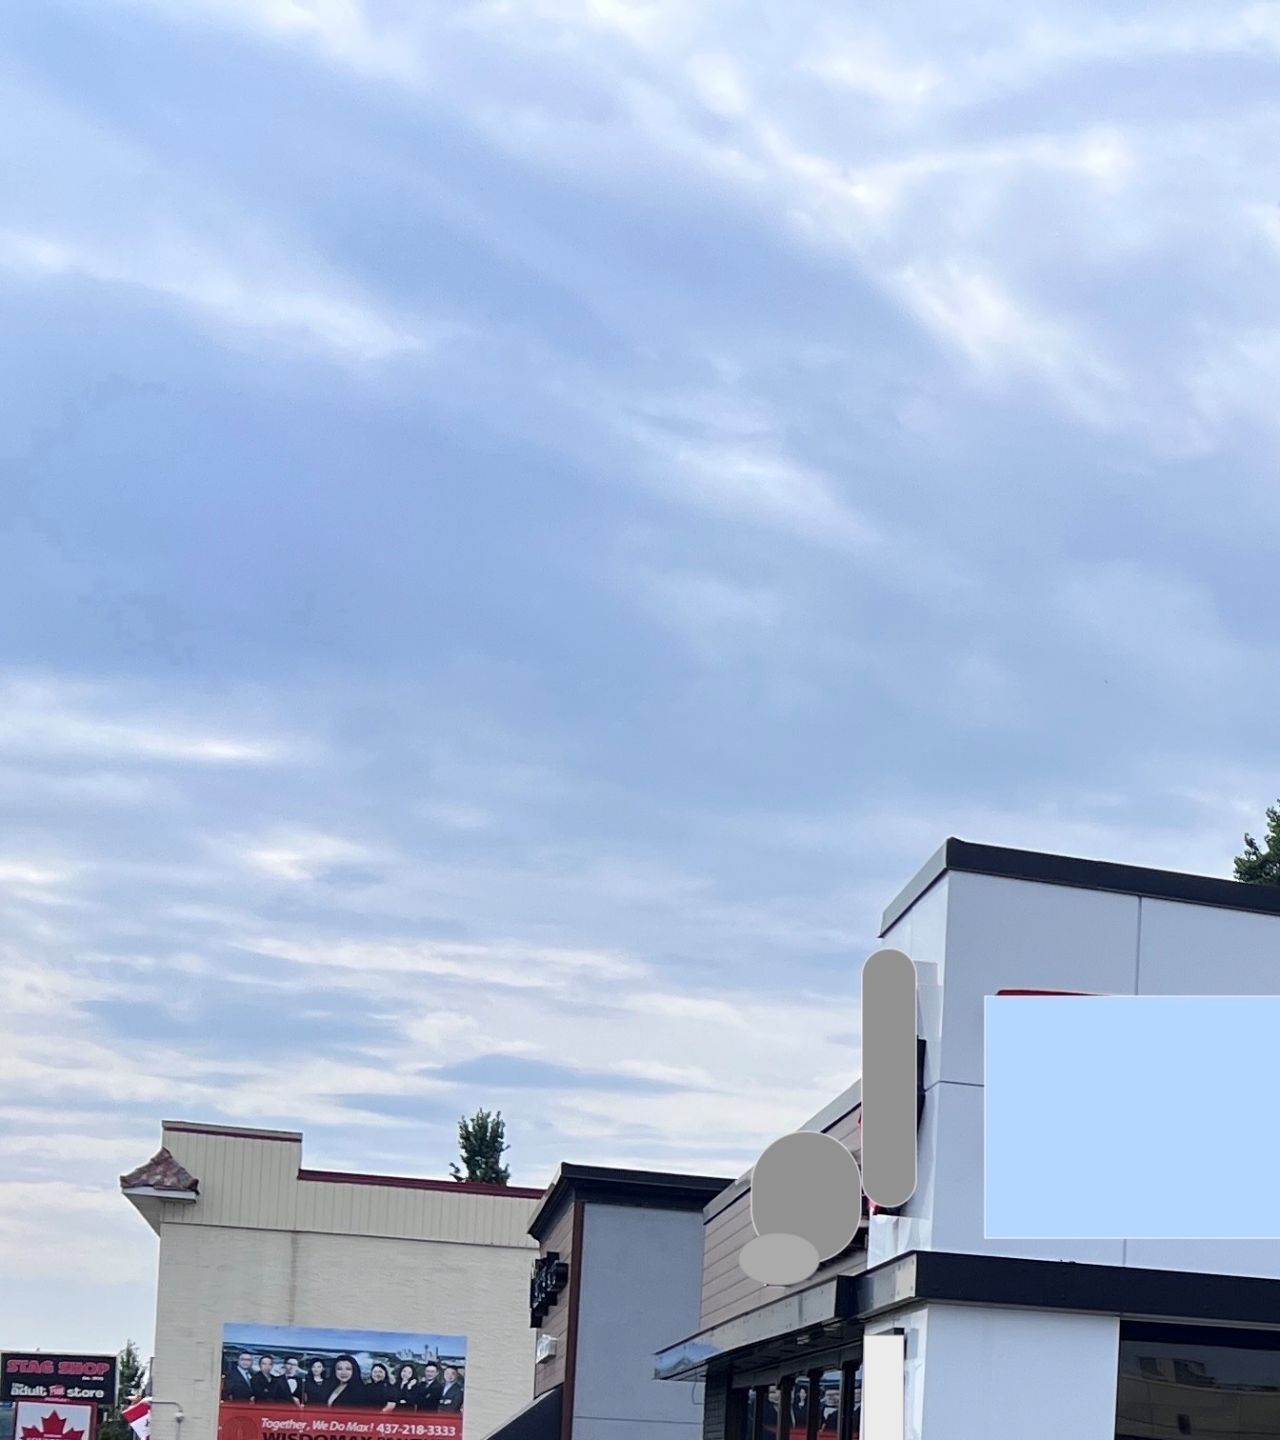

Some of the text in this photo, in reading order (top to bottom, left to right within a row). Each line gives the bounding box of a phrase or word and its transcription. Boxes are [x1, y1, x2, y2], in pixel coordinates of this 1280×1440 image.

[6, 1360, 110, 1375] STAG SHOP
[10, 1385, 47, 1396] adult
[66, 1388, 104, 1398] store
[312, 1420, 329, 1430] We
[329, 1421, 345, 1431] Do
[376, 1423, 456, 1436] 437-218-3333
